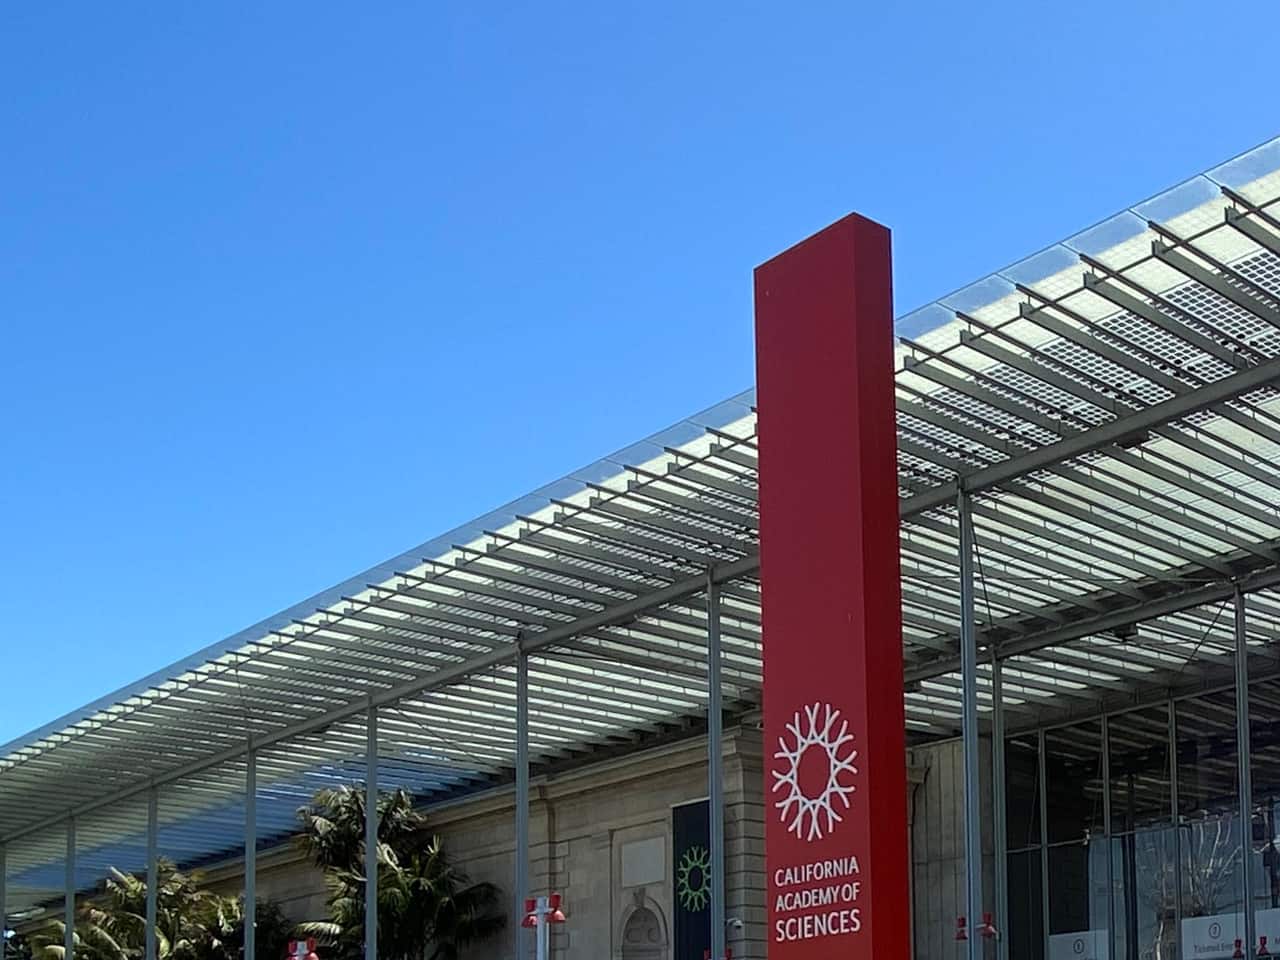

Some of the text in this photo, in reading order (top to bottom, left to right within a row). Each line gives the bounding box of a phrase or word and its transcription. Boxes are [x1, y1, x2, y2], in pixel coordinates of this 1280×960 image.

[775, 856, 860, 887] CALIFORNIA
[775, 882, 861, 912] ACADEMY OF
[775, 908, 861, 942] SCIENCES
